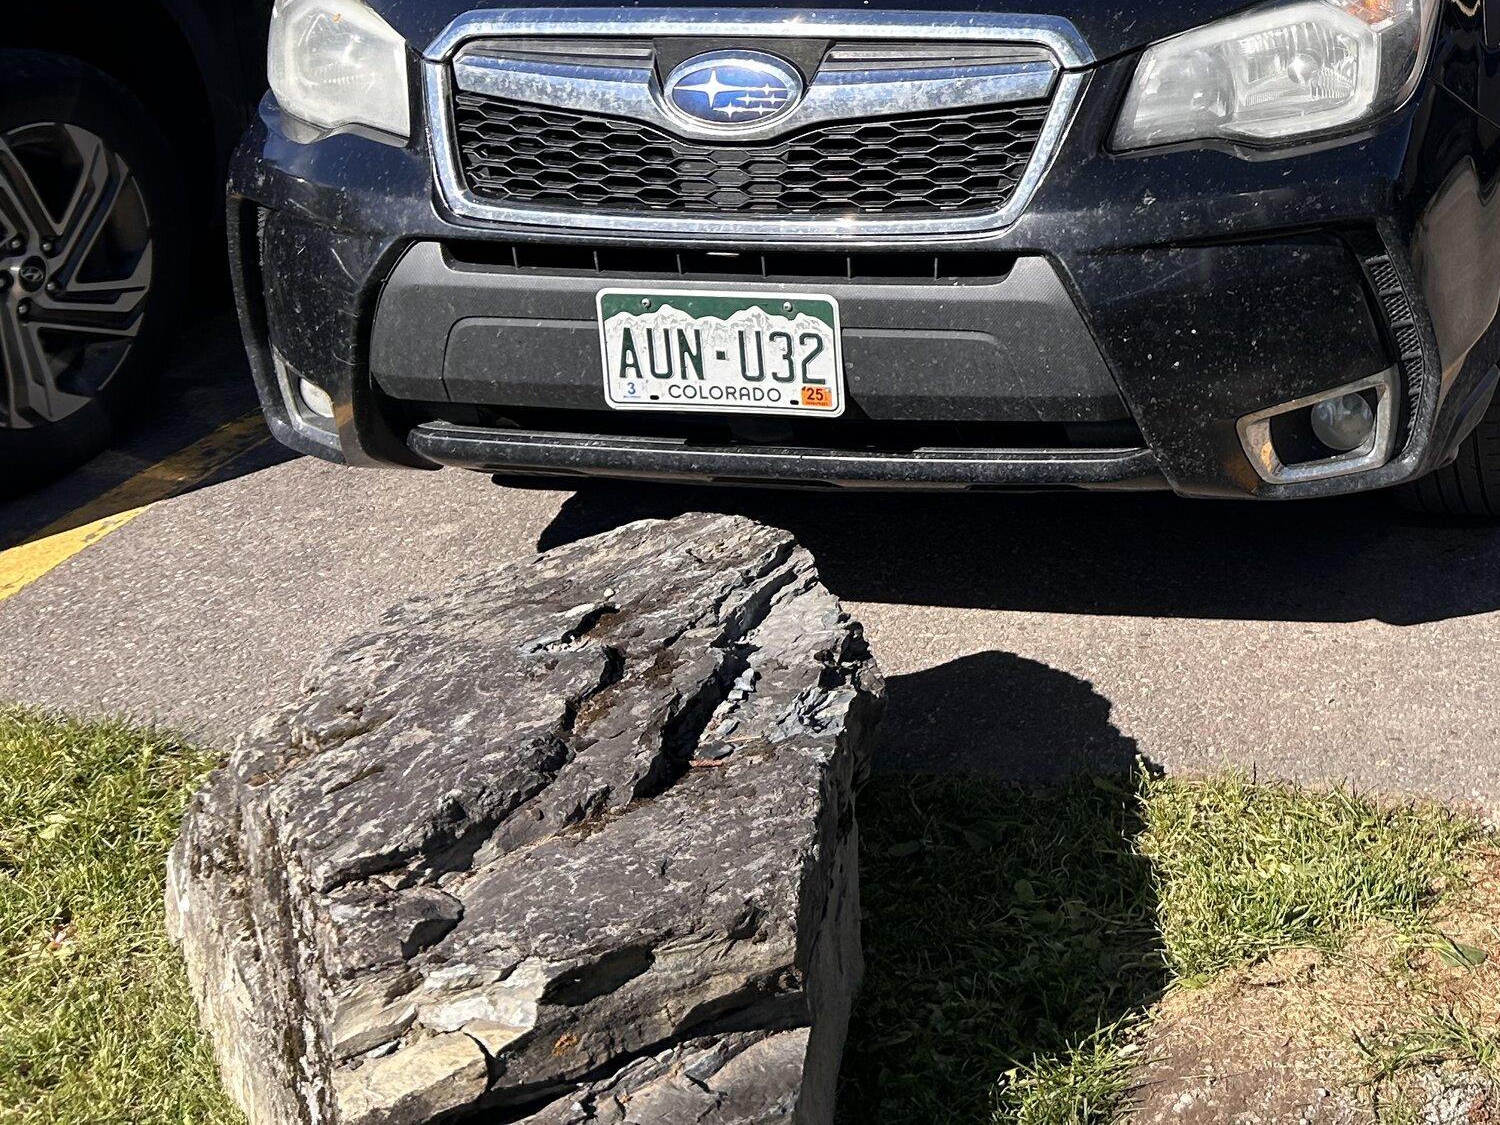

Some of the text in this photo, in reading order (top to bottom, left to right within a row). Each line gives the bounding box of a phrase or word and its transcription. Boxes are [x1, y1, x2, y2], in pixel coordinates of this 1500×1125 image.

[627, 382, 637, 395] 3
[668, 384, 782, 402] COLORADO
[806, 387, 824, 401] 25
